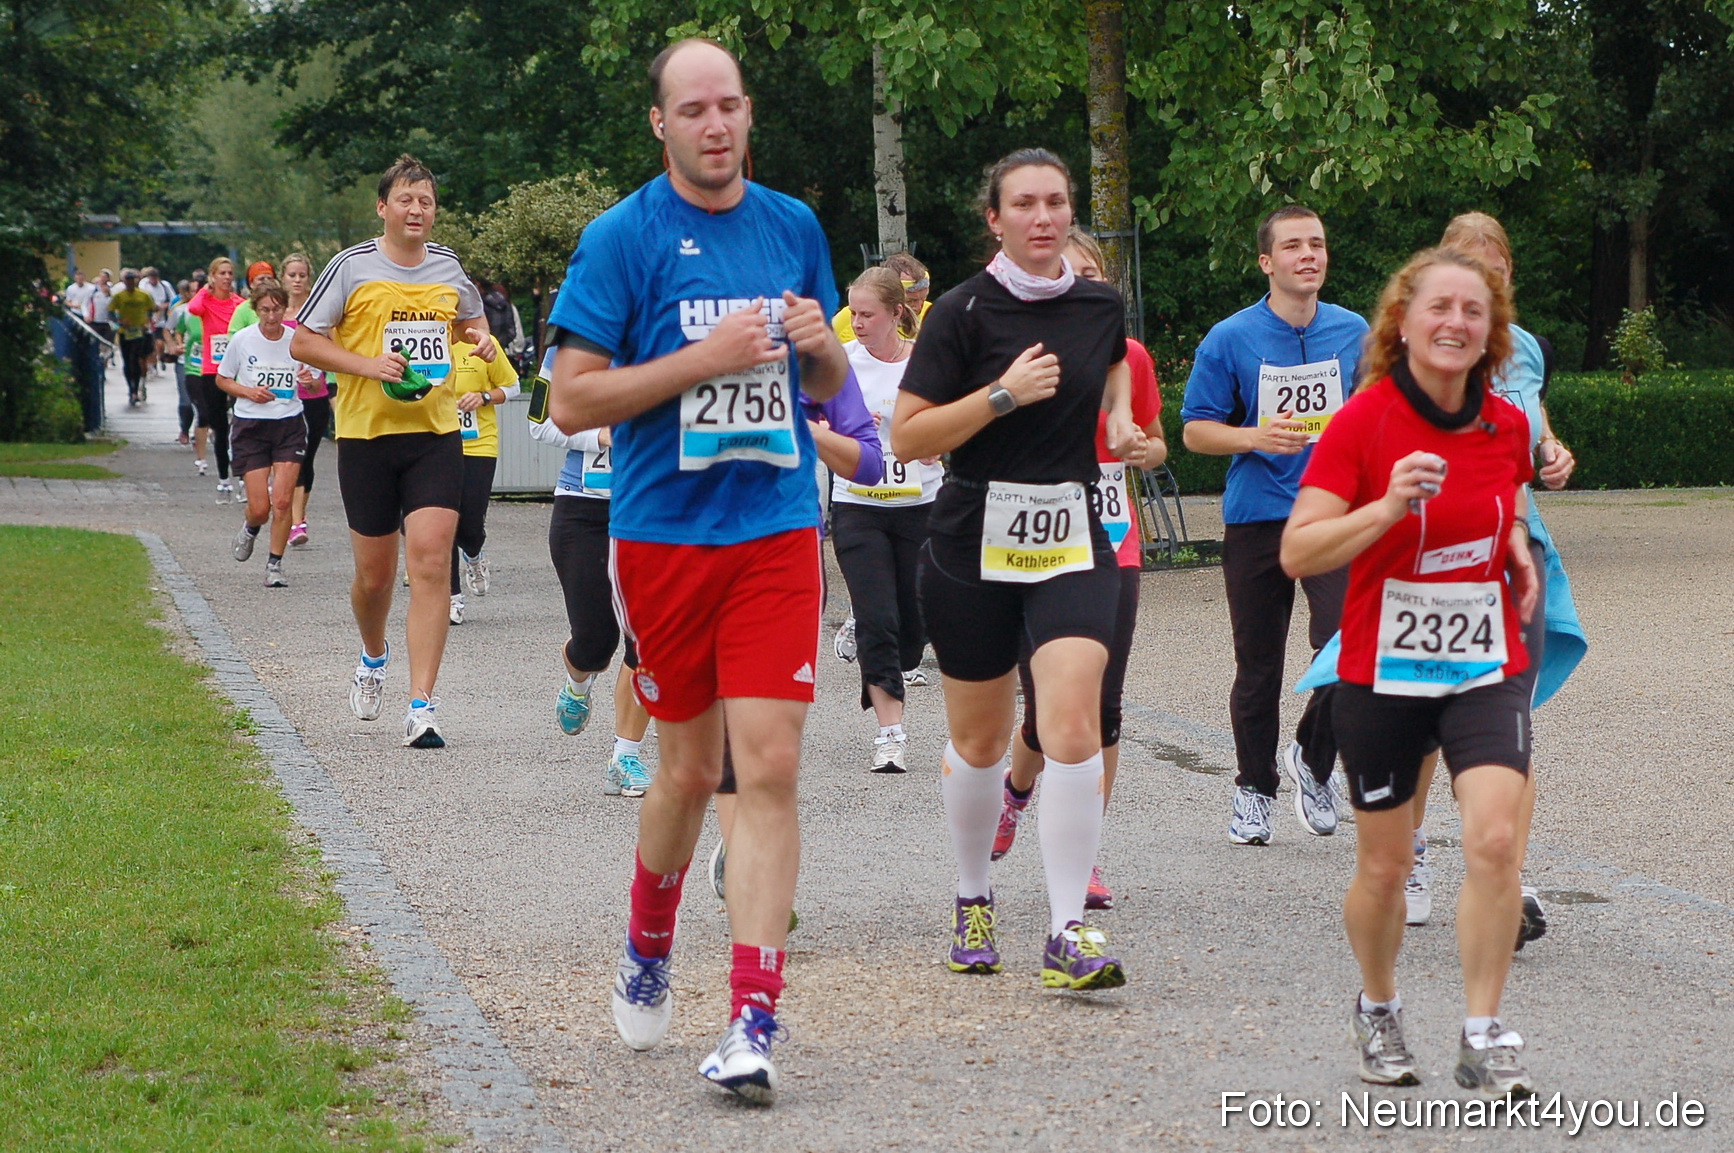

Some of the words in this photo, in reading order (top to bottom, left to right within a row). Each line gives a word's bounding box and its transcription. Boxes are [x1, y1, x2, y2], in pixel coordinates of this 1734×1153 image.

[384, 327, 407, 335] PARTL
[257, 372, 294, 388] 2679
[1261, 373, 1290, 383] PARTL
[1291, 371, 1328, 382] Neumarkt
[695, 380, 786, 425] 2758
[1276, 382, 1328, 414] 283
[717, 433, 770, 452] Florian
[989, 491, 1026, 504] PARTL
[1006, 508, 1071, 545] 490
[1005, 553, 1066, 569] Kathleen
[1441, 550, 1474, 564] DEHN
[1386, 590, 1428, 607] PARTL
[1430, 596, 1483, 607] Neumarkt
[1393, 610, 1494, 654] 2324
